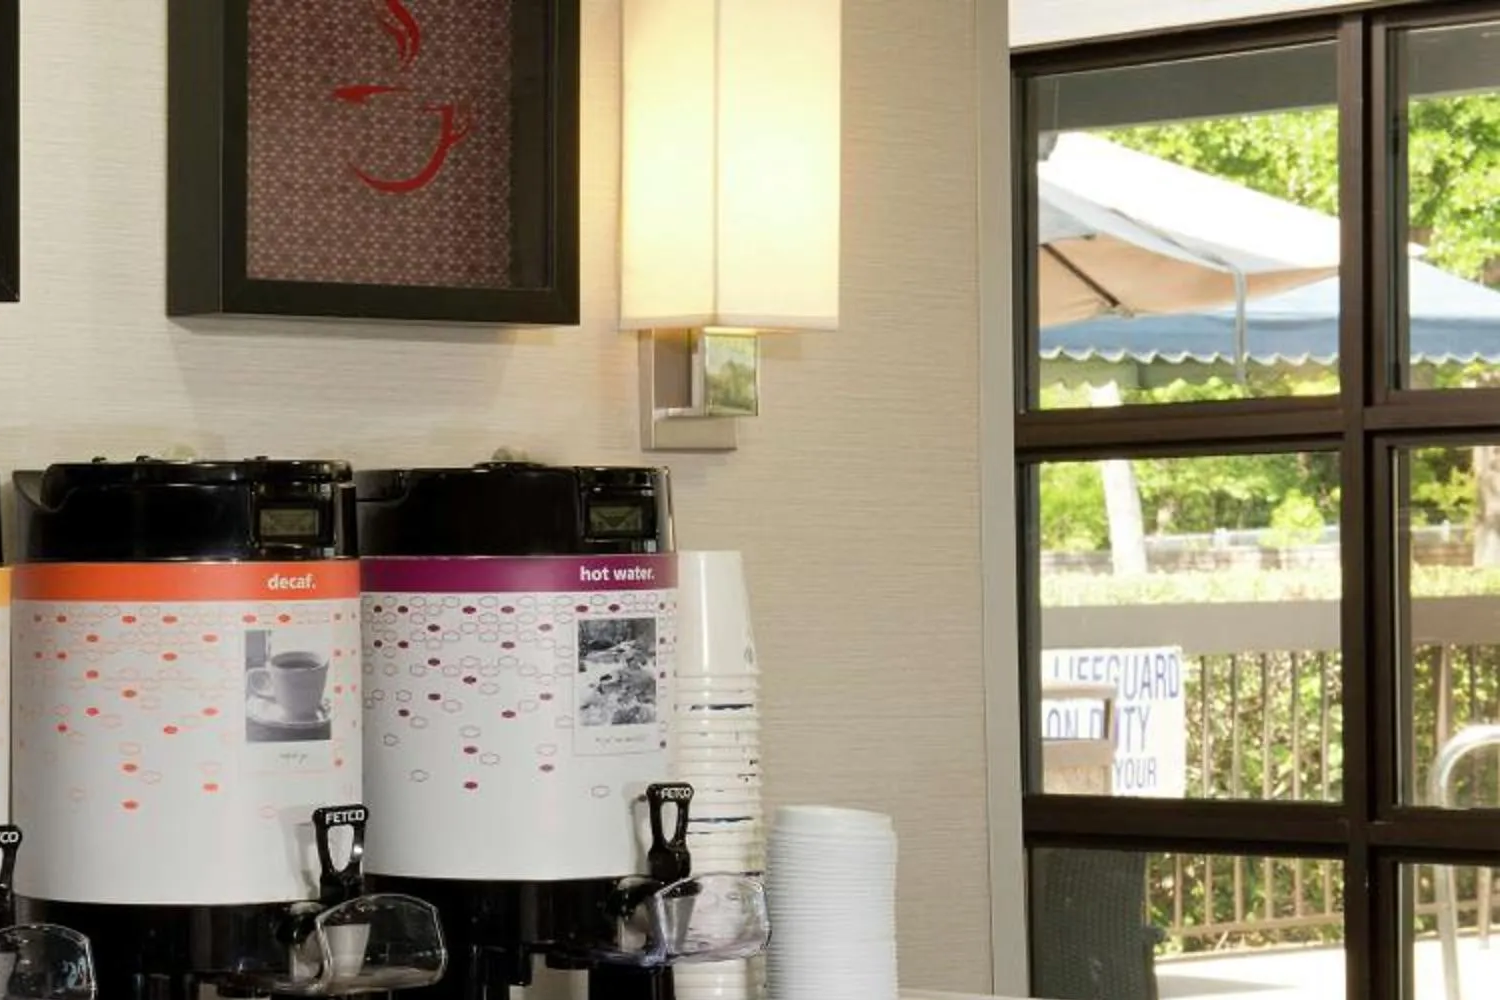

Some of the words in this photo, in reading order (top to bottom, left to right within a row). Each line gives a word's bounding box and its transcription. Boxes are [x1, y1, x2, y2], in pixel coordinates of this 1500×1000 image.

[267, 573, 316, 590] decaf.
[580, 566, 609, 581] hot
[613, 568, 655, 581] water.
[1089, 704, 1152, 753] DTY
[325, 809, 365, 824] FETCO
